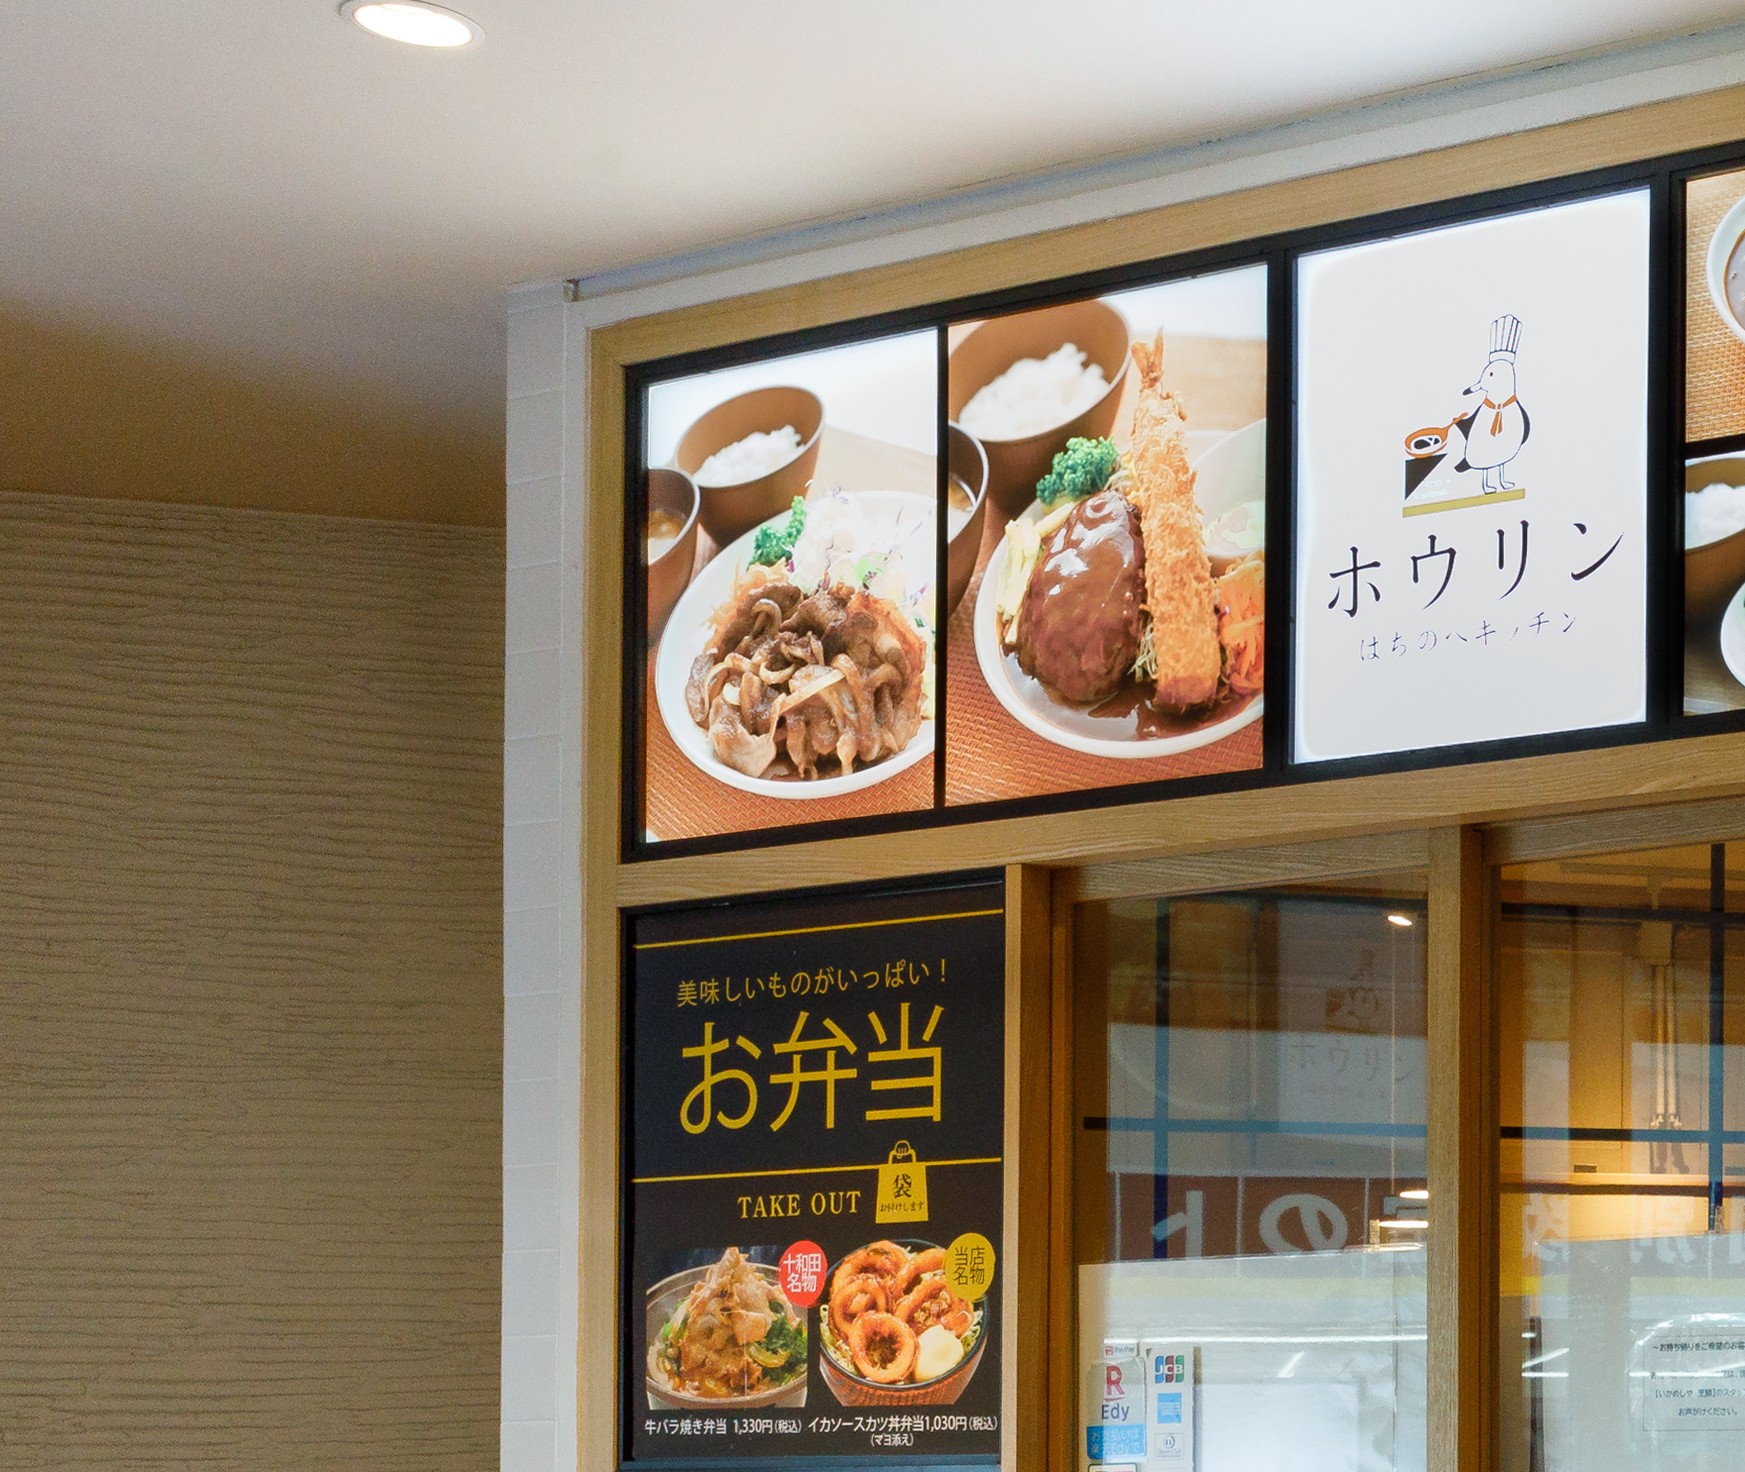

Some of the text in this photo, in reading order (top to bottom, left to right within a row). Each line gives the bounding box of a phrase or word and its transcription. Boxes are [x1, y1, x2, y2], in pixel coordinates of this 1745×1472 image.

[1327, 519, 1625, 619] ホウリン
[1359, 611, 1577, 662] はちのへキッチン
[678, 958, 948, 1008] 美味しいものがいっぱい！
[680, 1001, 944, 1135] お弁当
[892, 1173, 913, 1199] 袋
[738, 1191, 862, 1219] TAKE OUT
[783, 1253, 821, 1274] 十和田
[954, 1245, 986, 1266] 当店
[787, 1272, 818, 1293] 名物
[953, 1266, 986, 1286] 名物
[1106, 1365, 1125, 1396] R
[1155, 1360, 1184, 1379] JCB
[1101, 1404, 1130, 1422] Edy
[644, 1417, 728, 1436] 牛バラ焼き弁当
